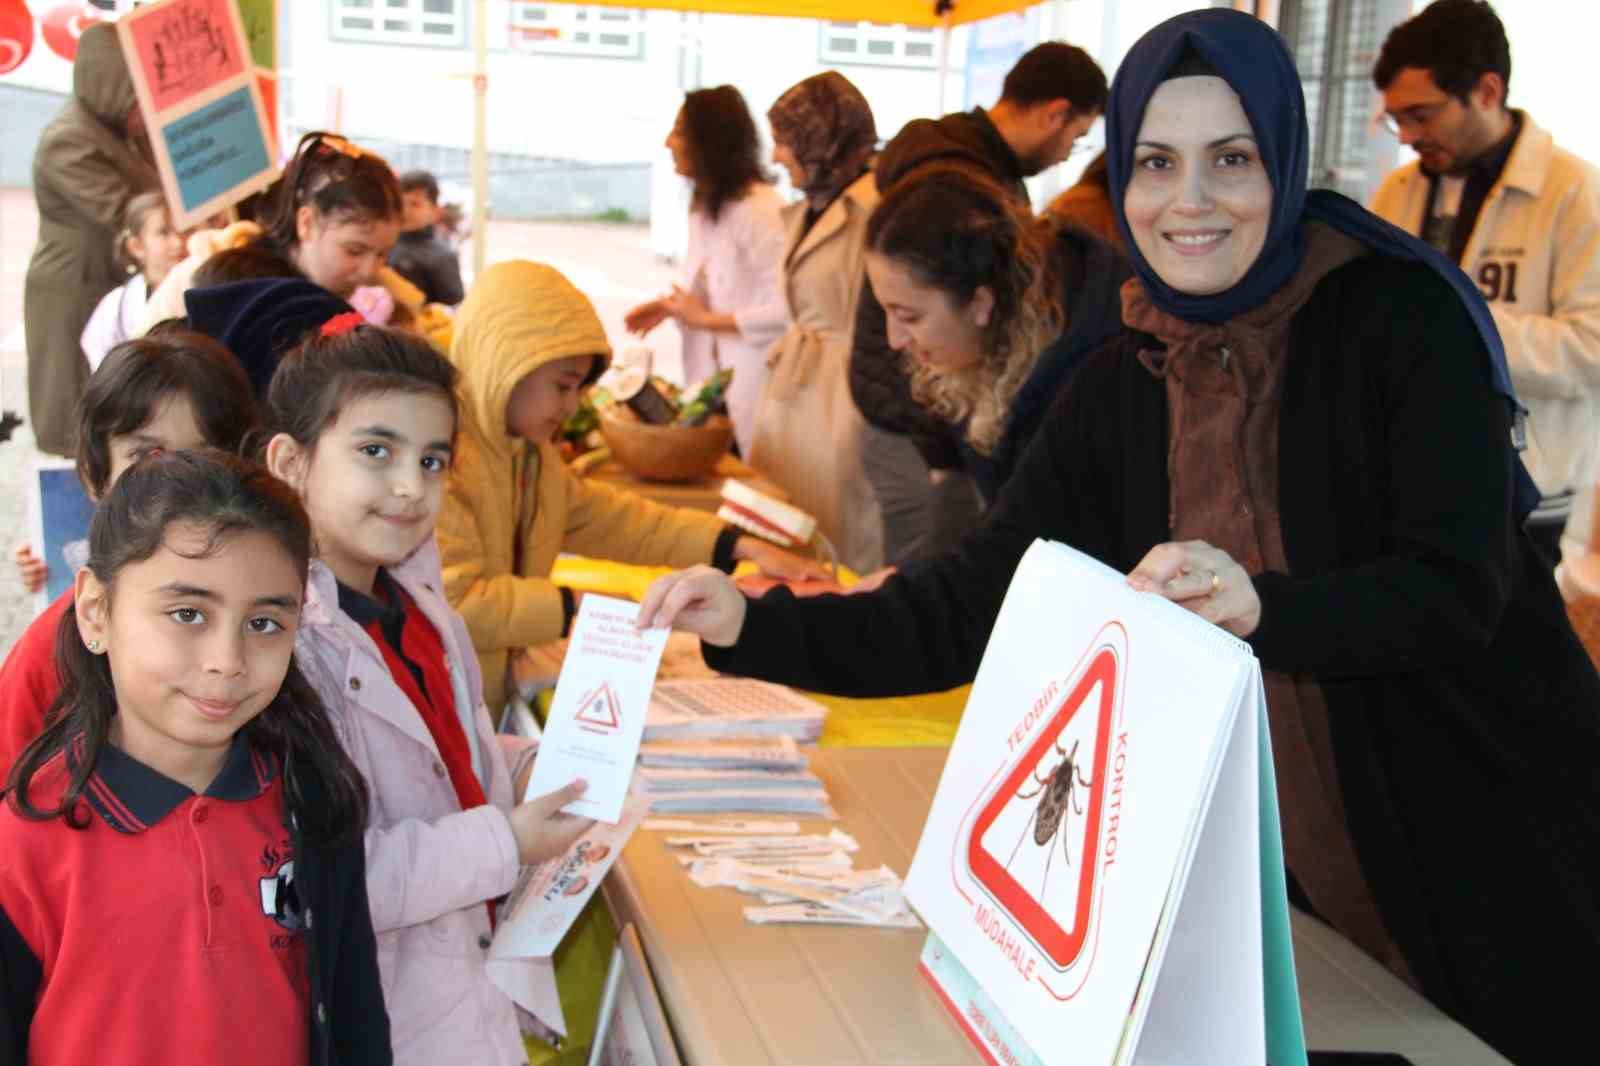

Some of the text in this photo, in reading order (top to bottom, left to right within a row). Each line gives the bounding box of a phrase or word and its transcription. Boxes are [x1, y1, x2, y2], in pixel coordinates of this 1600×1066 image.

[1478, 261, 1518, 304] 91
[1103, 731, 1128, 877] KONTROL
[974, 903, 1037, 982] MÜDAHALE
